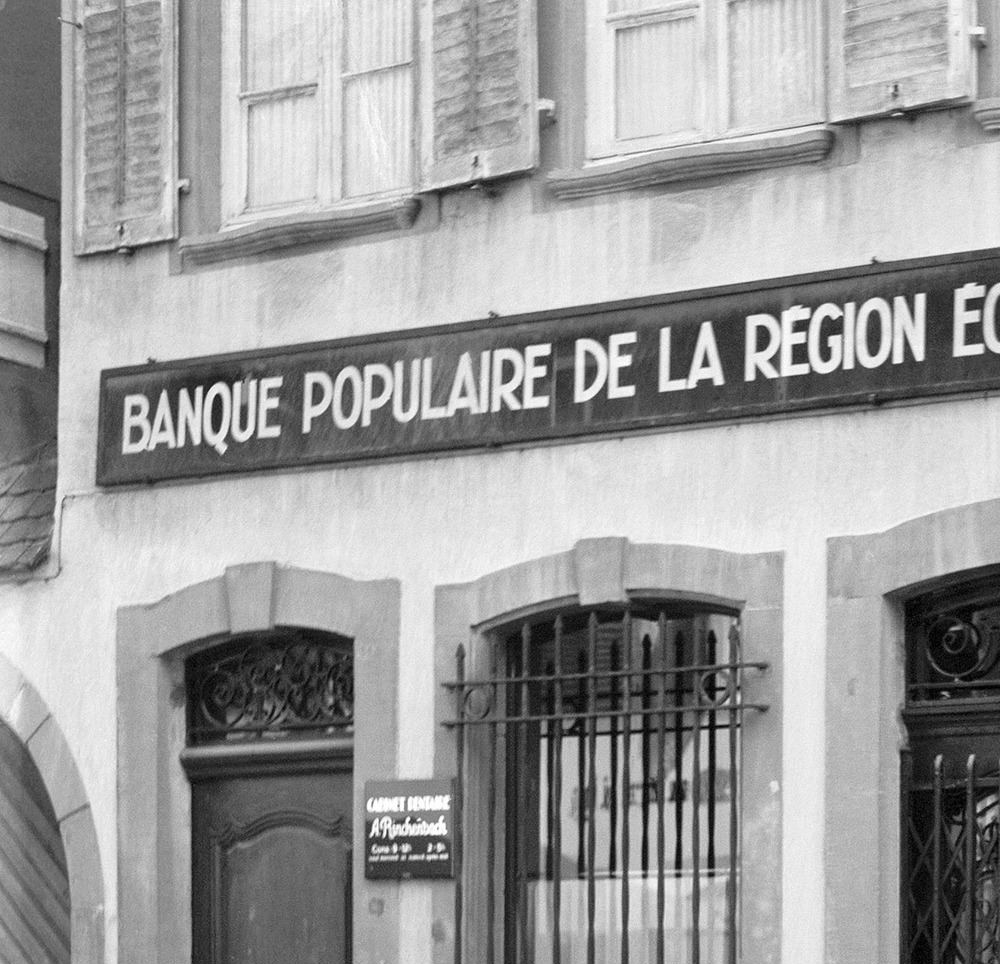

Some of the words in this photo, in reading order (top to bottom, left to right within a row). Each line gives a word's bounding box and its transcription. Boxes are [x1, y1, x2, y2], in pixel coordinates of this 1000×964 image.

[121, 376, 284, 456] BANQUE
[302, 344, 552, 434] POPULAIRE
[574, 331, 638, 403] DE
[658, 321, 725, 393] LA
[744, 293, 927, 382] RÉGION
[366, 796, 406, 812] CABINET
[407, 794, 451, 811] DENTAIRE
